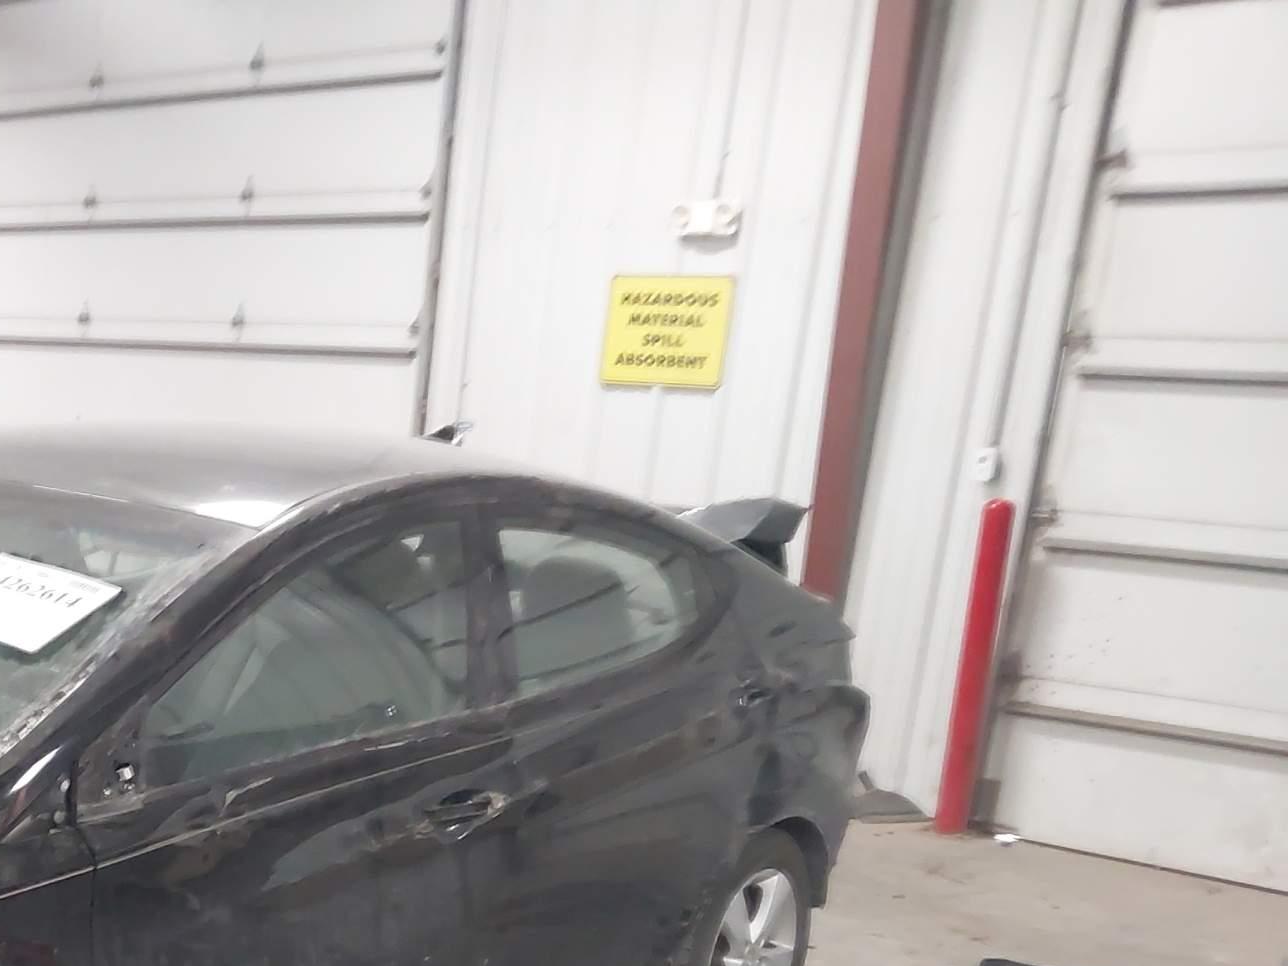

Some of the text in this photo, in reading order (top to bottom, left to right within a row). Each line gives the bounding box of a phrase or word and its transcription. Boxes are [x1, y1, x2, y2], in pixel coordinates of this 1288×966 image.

[620, 292, 720, 307] HAZARDOUS
[628, 313, 706, 327] MATERIAL
[641, 333, 685, 347] SPILL
[614, 352, 708, 369] ABSORBENT
